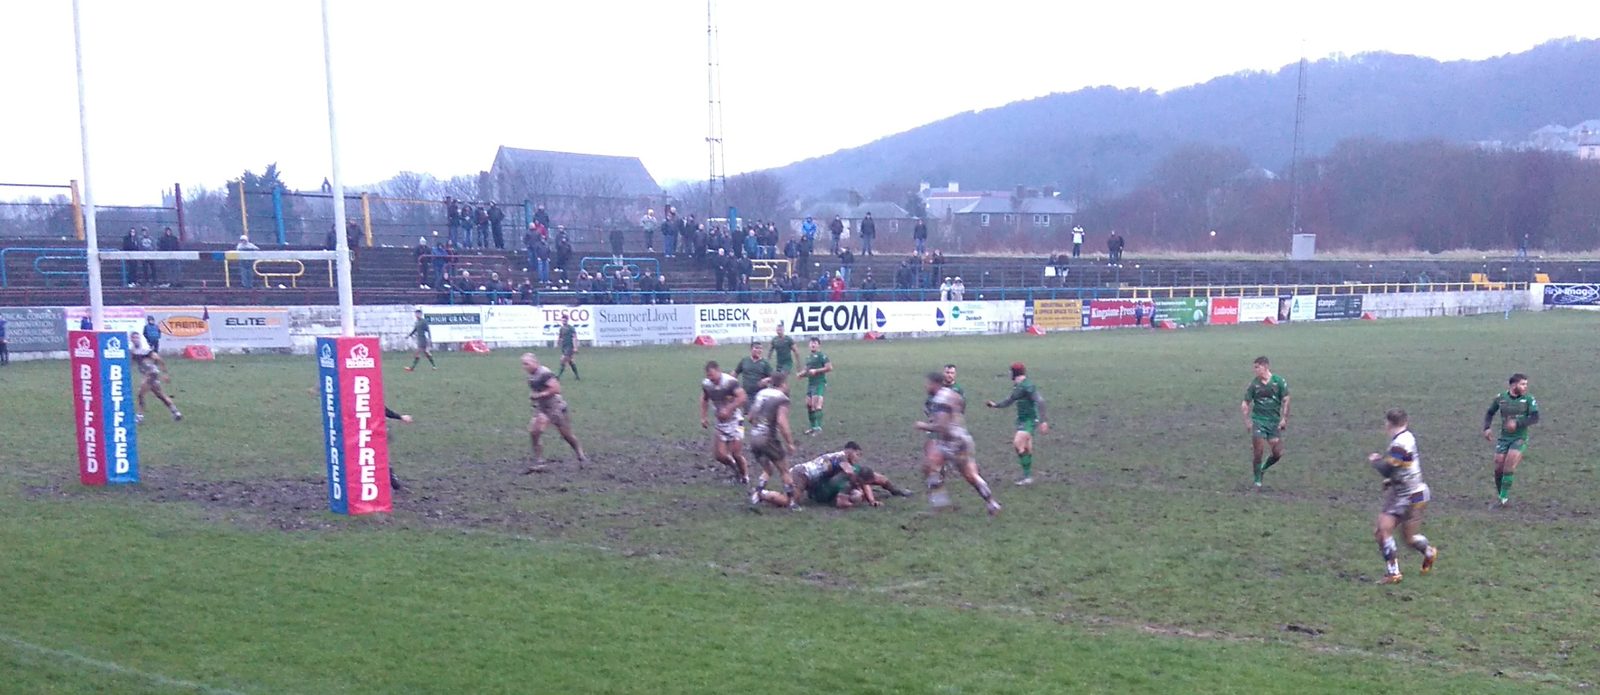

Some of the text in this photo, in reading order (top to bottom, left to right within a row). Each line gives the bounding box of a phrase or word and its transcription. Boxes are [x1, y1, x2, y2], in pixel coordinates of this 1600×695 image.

[542, 309, 590, 322] TESCO
[599, 308, 678, 327] StamperLloyd
[700, 308, 751, 321] EILBECK
[790, 304, 868, 332] AECOM
[80, 364, 98, 473] BETFRED
[110, 364, 130, 474] BETFRED
[325, 375, 342, 500] BETFRED
[354, 375, 379, 501] BETFRED
